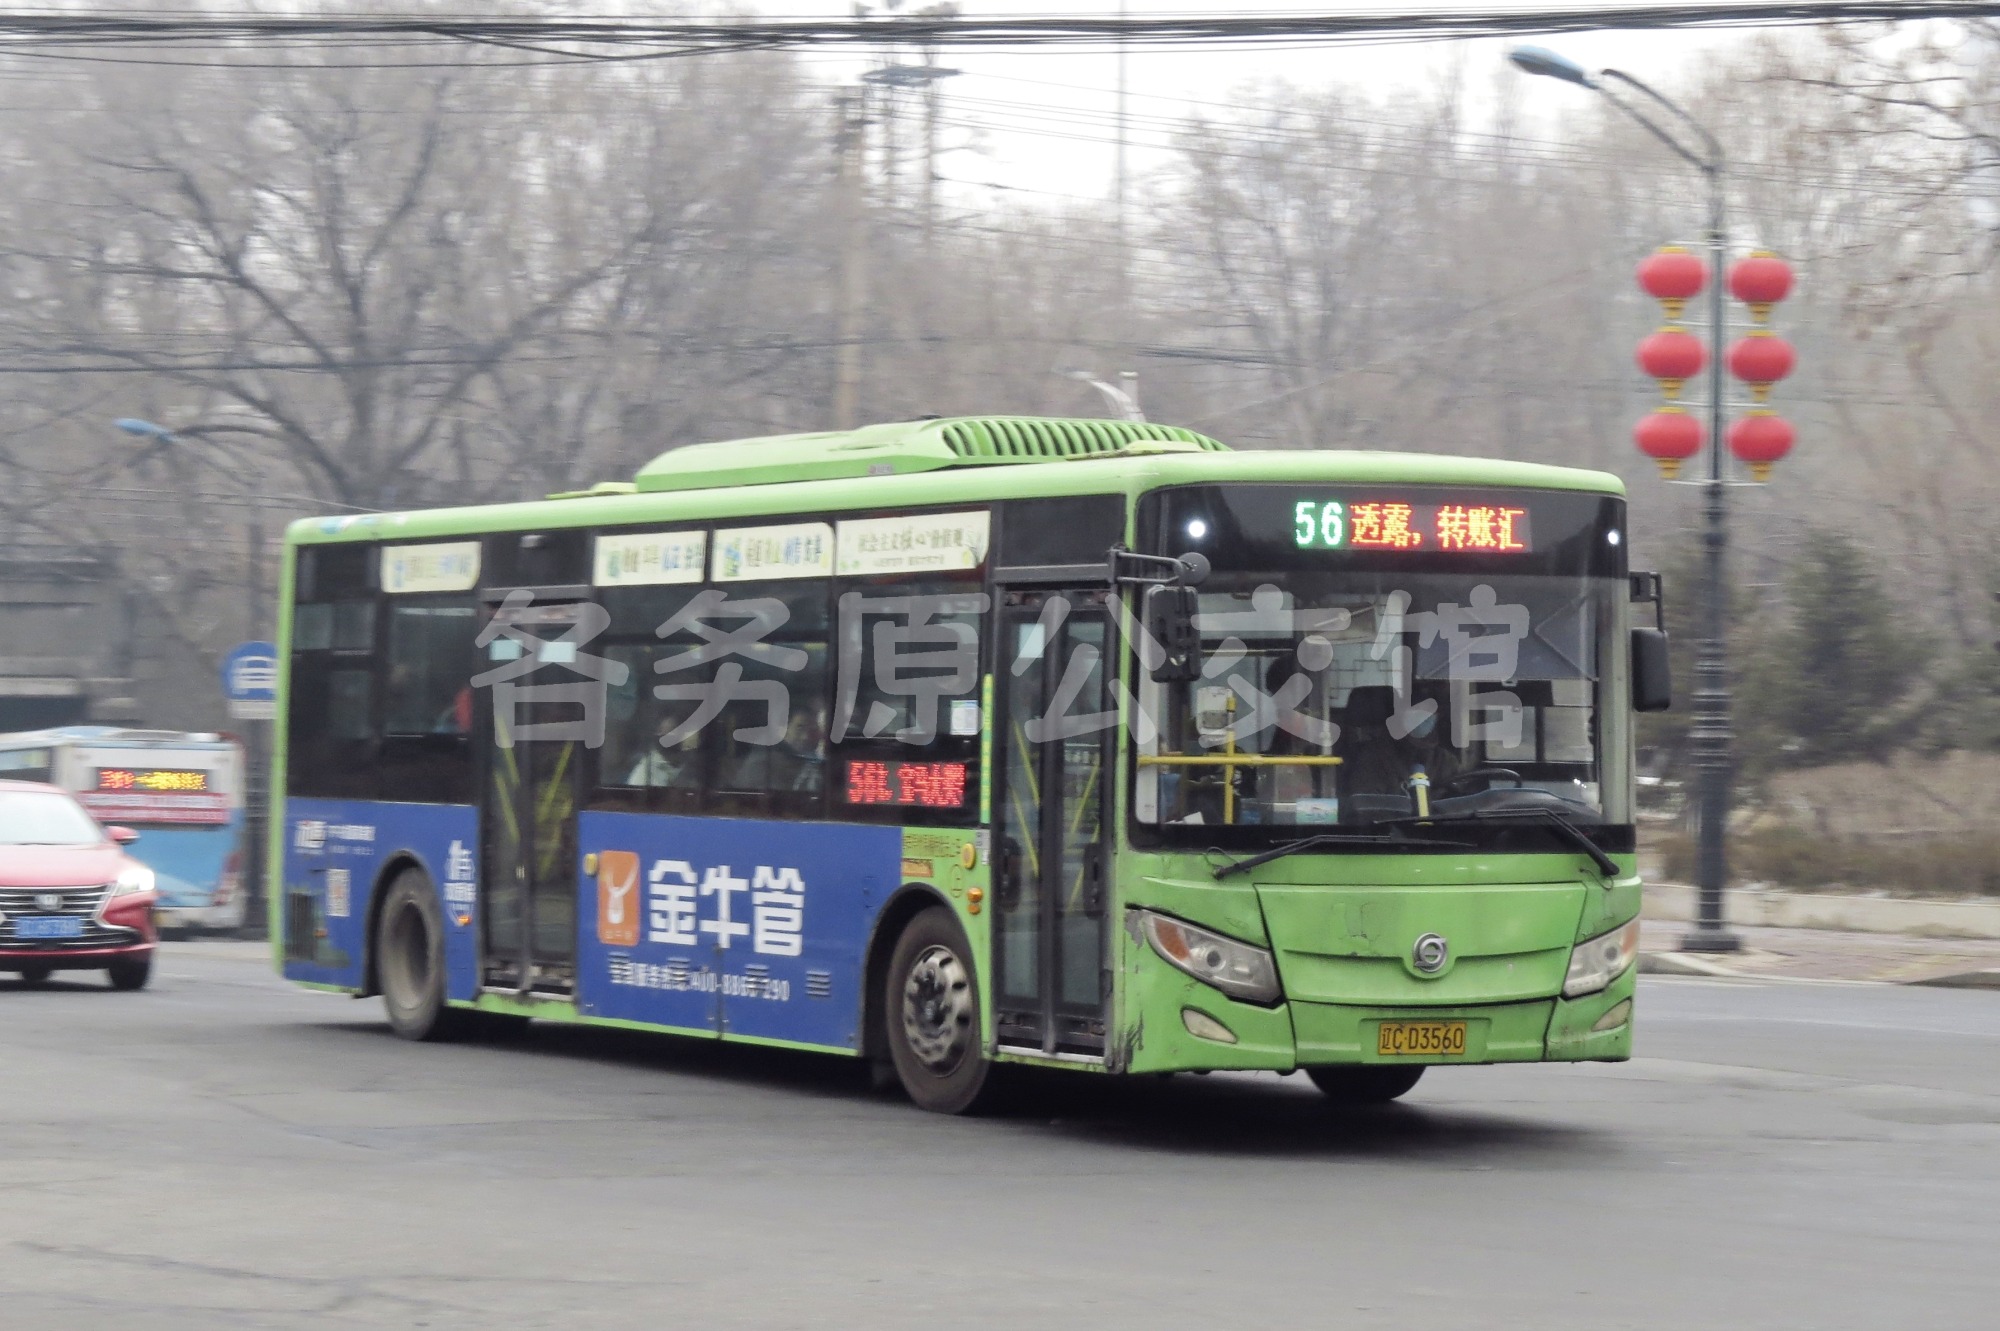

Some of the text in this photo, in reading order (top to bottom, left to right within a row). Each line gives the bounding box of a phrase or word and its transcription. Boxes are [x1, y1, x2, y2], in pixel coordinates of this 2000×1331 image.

[1295, 501, 1343, 546] 56
[648, 859, 805, 957] 金牛管
